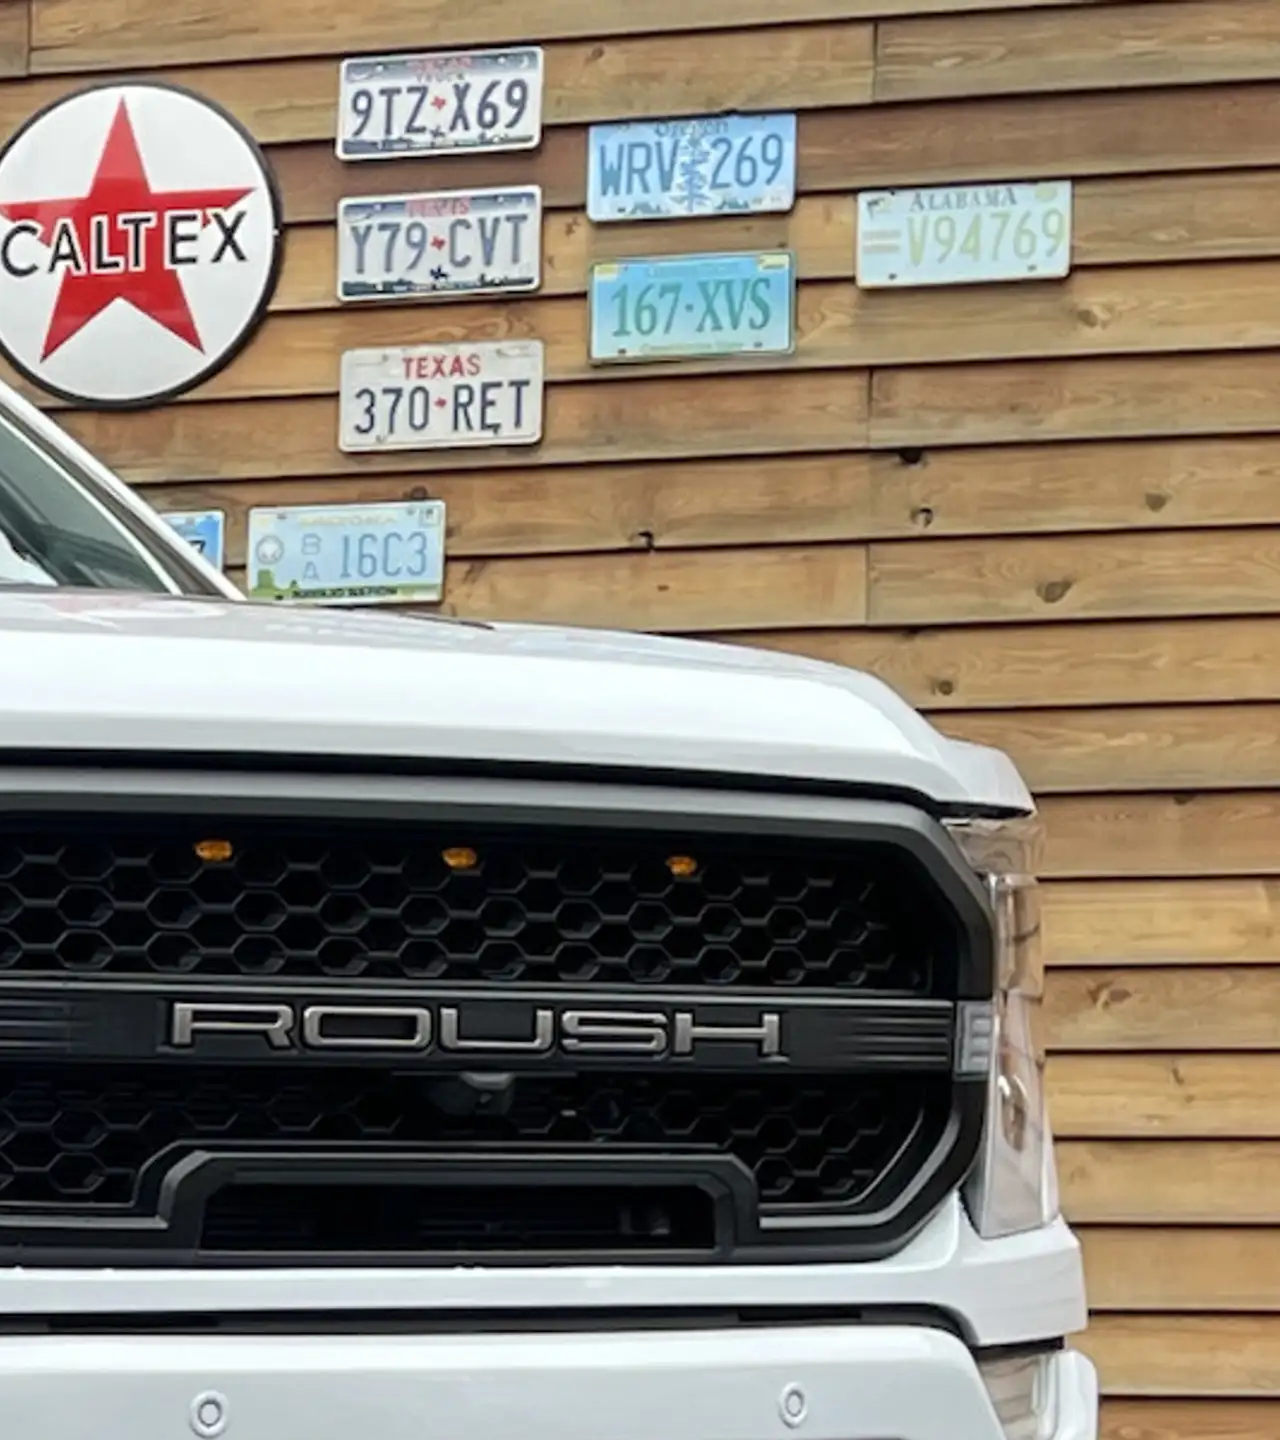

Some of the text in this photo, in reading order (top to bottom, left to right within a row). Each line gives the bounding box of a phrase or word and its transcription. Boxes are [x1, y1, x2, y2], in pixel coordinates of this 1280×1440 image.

[351, 78, 529, 137] 9TZ X69
[599, 132, 784, 197] WRV 269
[909, 186, 1018, 212] ALABAMA
[0, 210, 248, 278] CALTEX
[350, 214, 528, 275] Y79 CVT
[906, 208, 1065, 267] V94769
[402, 354, 481, 380] TEXAS
[353, 379, 531, 435] 370 RET
[341, 531, 428, 579] 16C3
[170, 1001, 782, 1058] ROUSH
